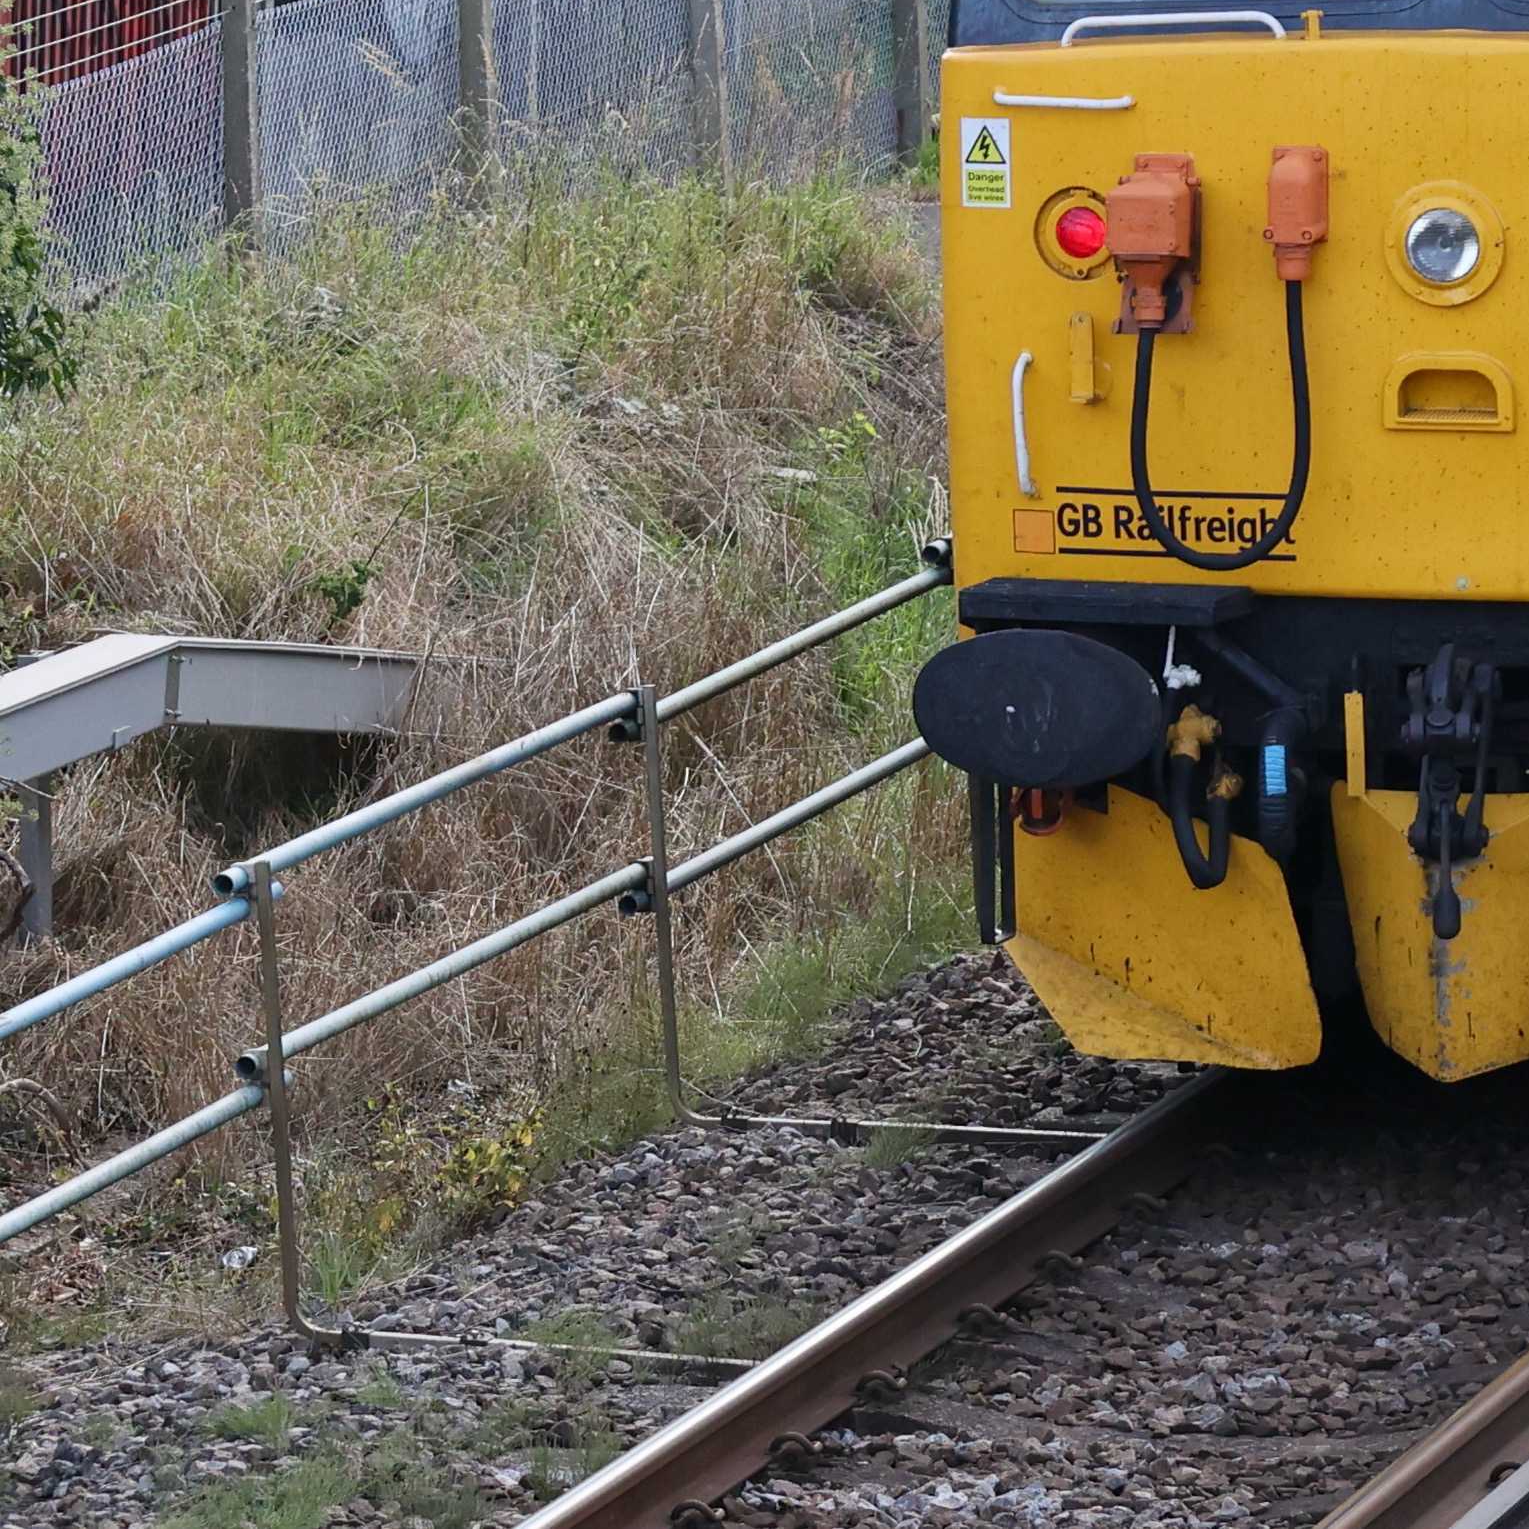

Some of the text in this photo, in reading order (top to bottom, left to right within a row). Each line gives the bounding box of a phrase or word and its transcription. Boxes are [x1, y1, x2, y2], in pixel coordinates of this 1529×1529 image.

[968, 171, 1004, 183] Danger
[968, 184, 1004, 192] Overhead
[1057, 502, 1103, 538] GB
